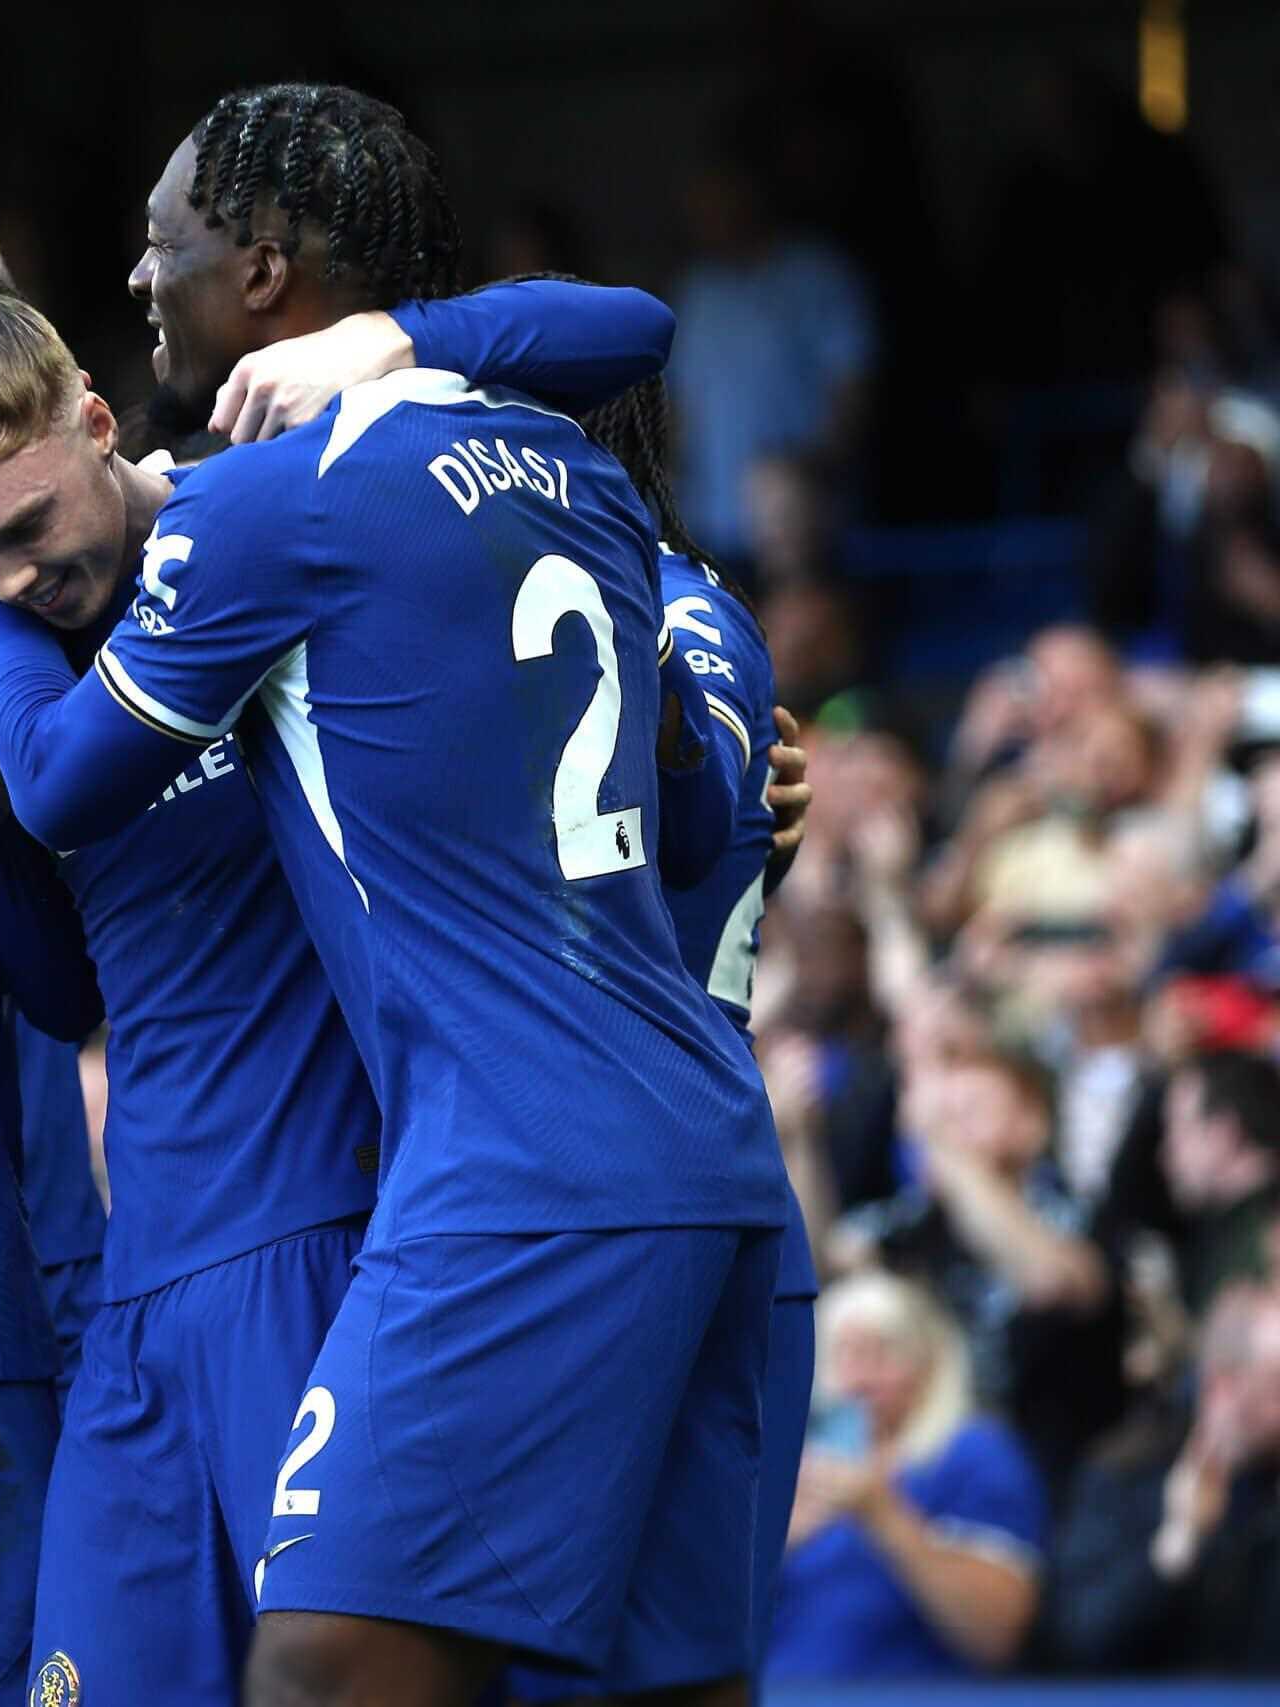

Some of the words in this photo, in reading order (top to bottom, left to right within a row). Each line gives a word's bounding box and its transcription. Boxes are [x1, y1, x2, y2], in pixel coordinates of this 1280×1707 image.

[427, 438, 570, 515] DISASI
[511, 553, 647, 881] 2
[272, 1385, 336, 1518] 2
